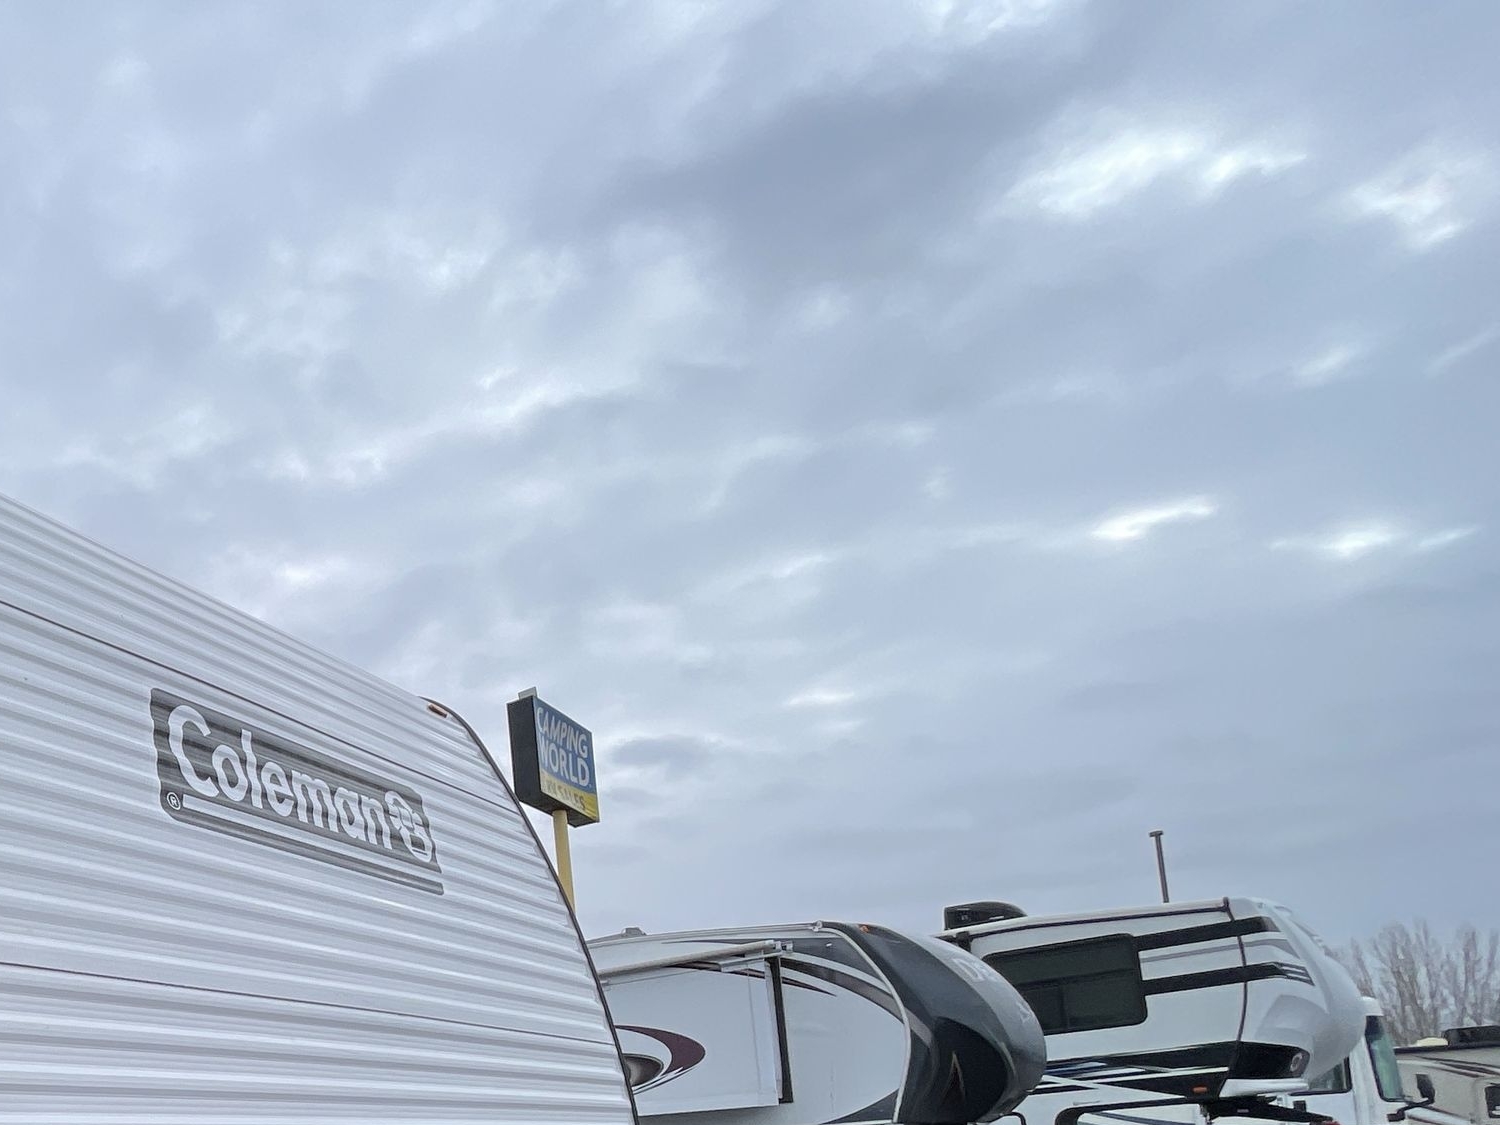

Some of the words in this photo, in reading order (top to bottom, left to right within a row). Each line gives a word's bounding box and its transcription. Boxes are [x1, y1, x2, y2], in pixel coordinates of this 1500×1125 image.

[536, 706, 589, 759] CAMPING
[168, 704, 393, 850] Coleman
[539, 735, 590, 787] WORLD
